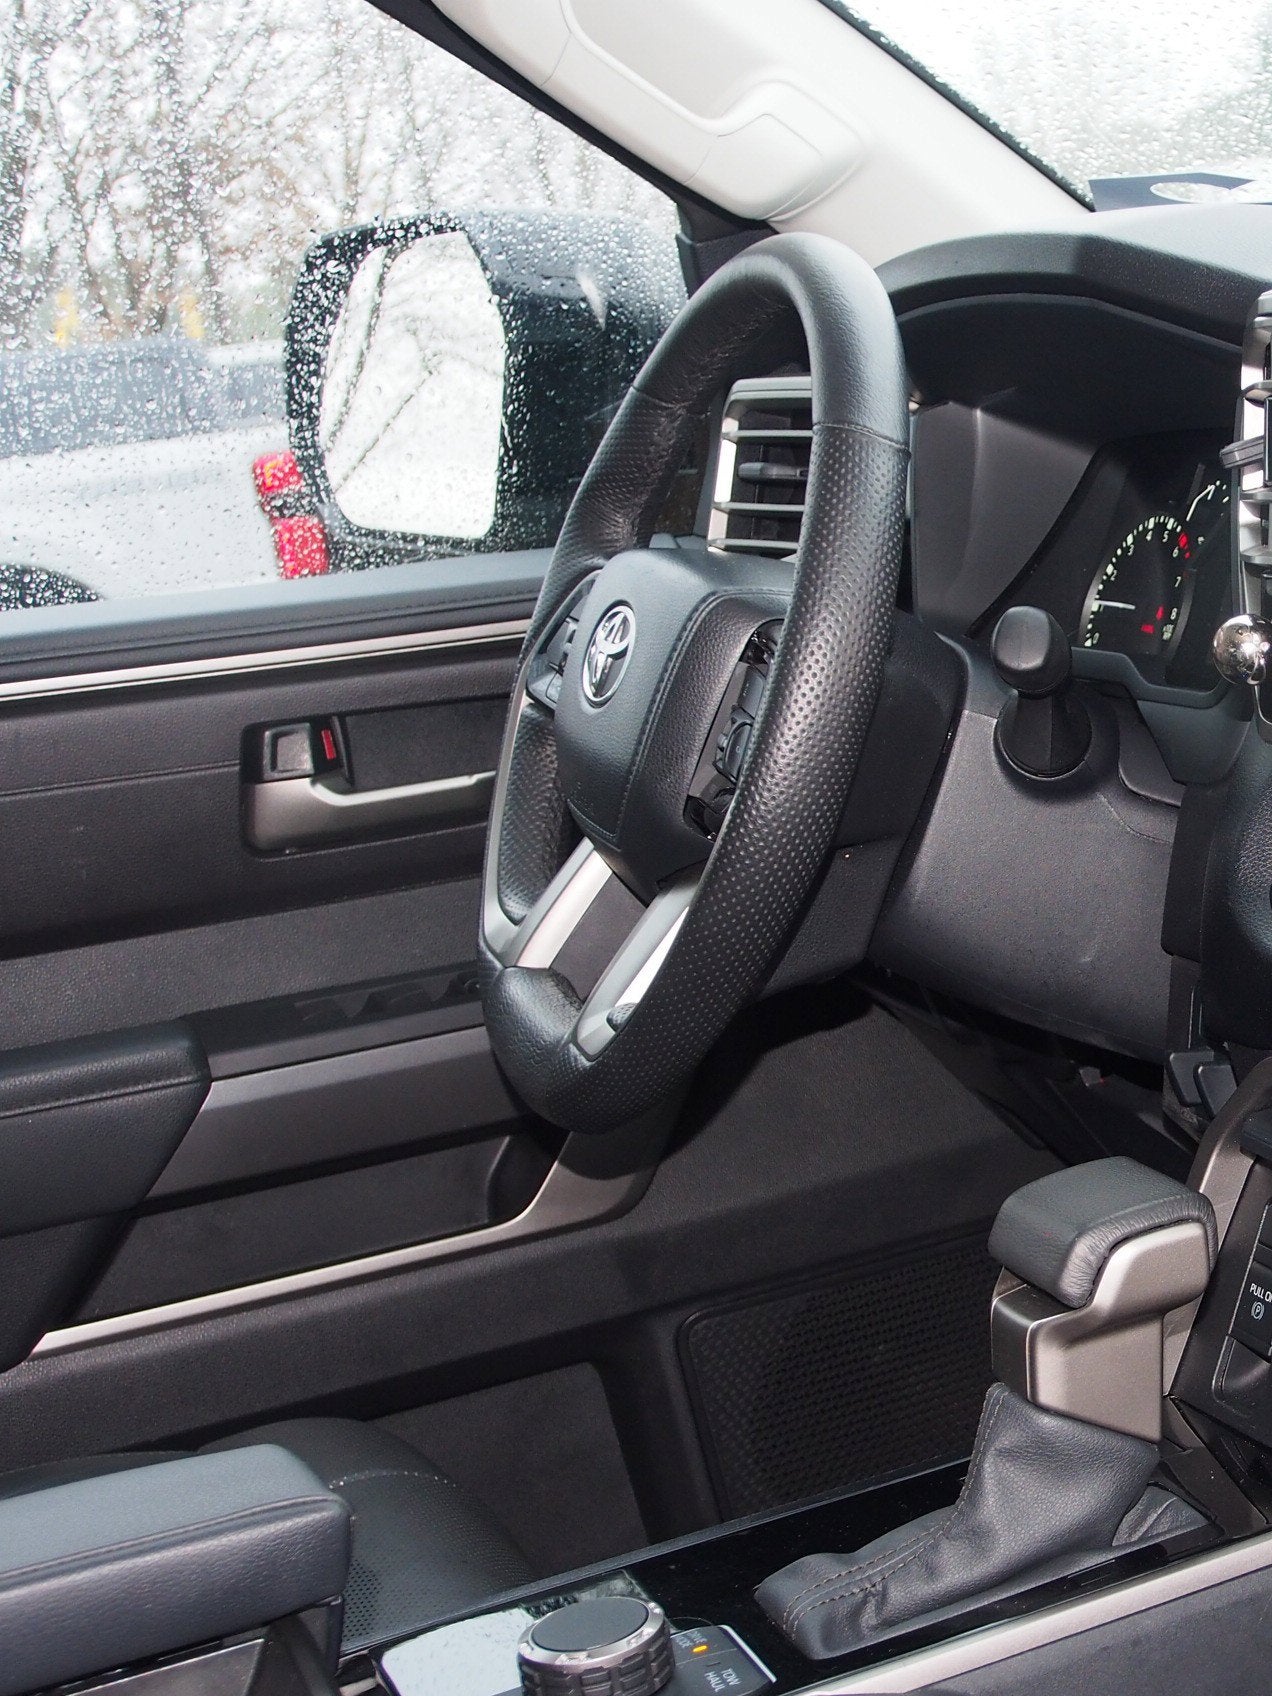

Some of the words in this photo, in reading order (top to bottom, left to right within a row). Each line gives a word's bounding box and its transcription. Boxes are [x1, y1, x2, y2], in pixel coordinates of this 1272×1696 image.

[1162, 531, 1169, 542] 5
[1127, 545, 1134, 555] 3
[1172, 546, 1179, 558] 6
[1111, 570, 1117, 580] 2
[1175, 576, 1182, 587] 7
[1170, 607, 1178, 620] 8
[1093, 633, 1099, 643] 0
[1249, 1282, 1266, 1299] PULL
[704, 1671, 726, 1693] HAUL
[721, 1668, 741, 1686] TOW
